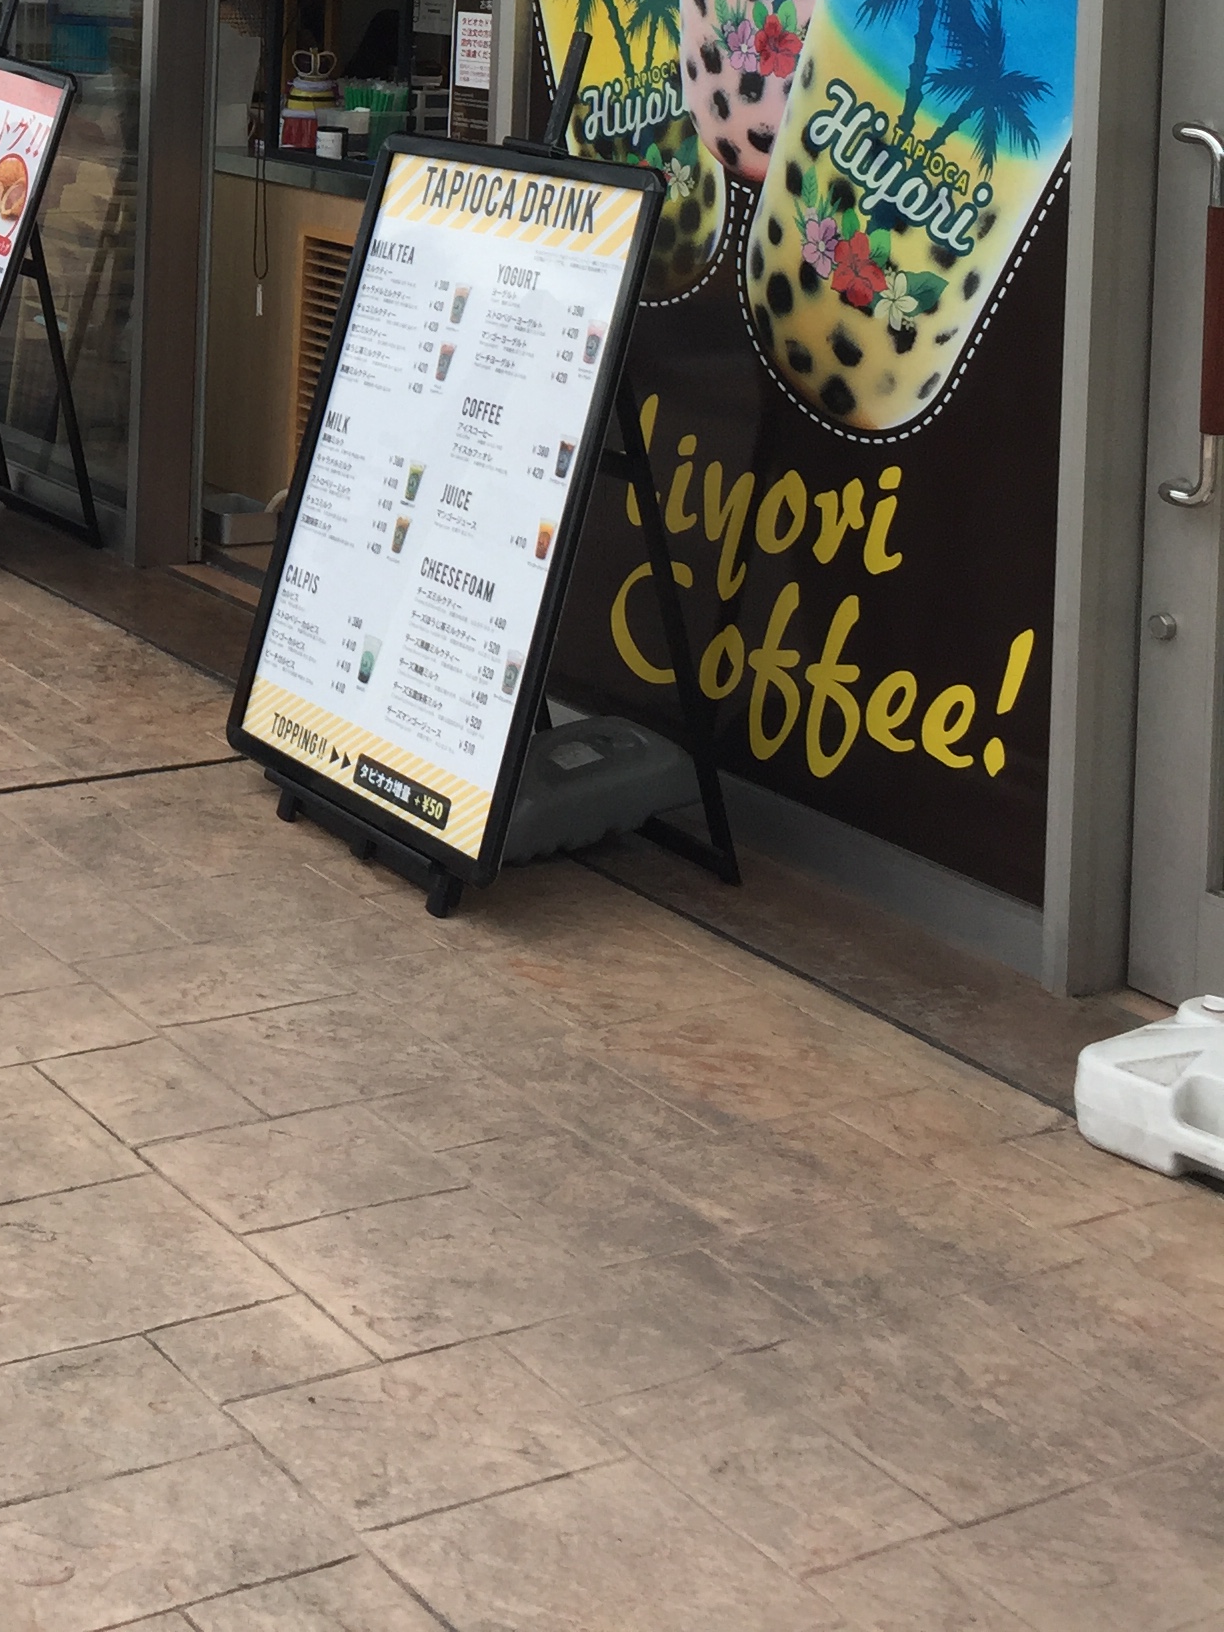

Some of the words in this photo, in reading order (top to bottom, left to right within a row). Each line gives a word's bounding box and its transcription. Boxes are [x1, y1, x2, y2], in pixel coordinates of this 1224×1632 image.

[626, 61, 678, 90] TAPIOCA
[582, 81, 688, 147] Hiyor
[809, 83, 989, 252] Hiyori
[892, 127, 970, 194] TAPIOCA
[421, 166, 518, 220] TAPIOCA
[519, 181, 602, 234] DRINK
[370, 238, 396, 260] MILK
[395, 243, 416, 264] TEA
[494, 263, 540, 291] YOGURT
[325, 410, 351, 434] MILK
[460, 395, 504, 426] COFFEE
[439, 482, 473, 512] JUICE
[284, 563, 320, 594] CALPIS
[419, 555, 463, 590] CHEESE
[460, 572, 496, 603] FOAM
[610, 562, 1035, 778] Coffee!
[360, 763, 412, 804] タピオカ増量
